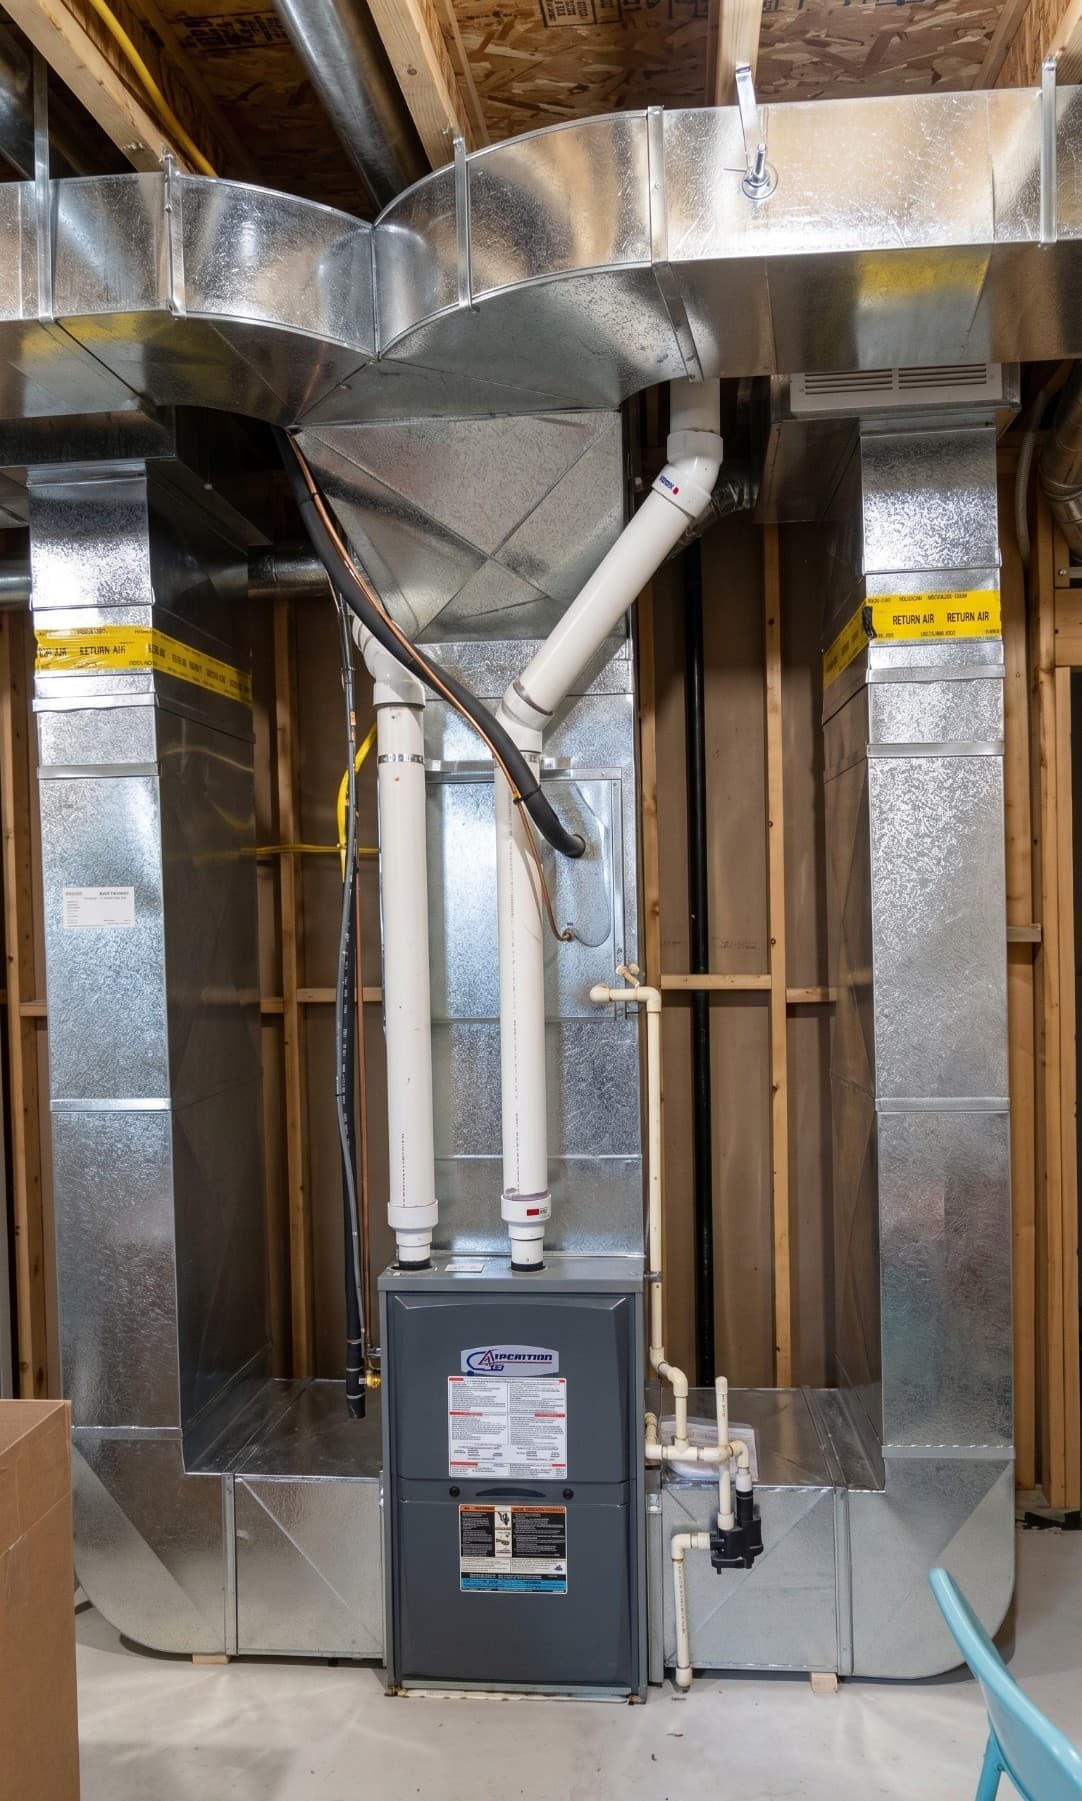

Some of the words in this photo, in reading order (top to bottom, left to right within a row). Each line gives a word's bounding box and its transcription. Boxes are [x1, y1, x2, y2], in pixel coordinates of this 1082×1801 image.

[892, 614, 921, 625] RETURN
[922, 613, 935, 624] AIR
[947, 612, 975, 623] RETURN
[977, 611, 990, 621] AIR
